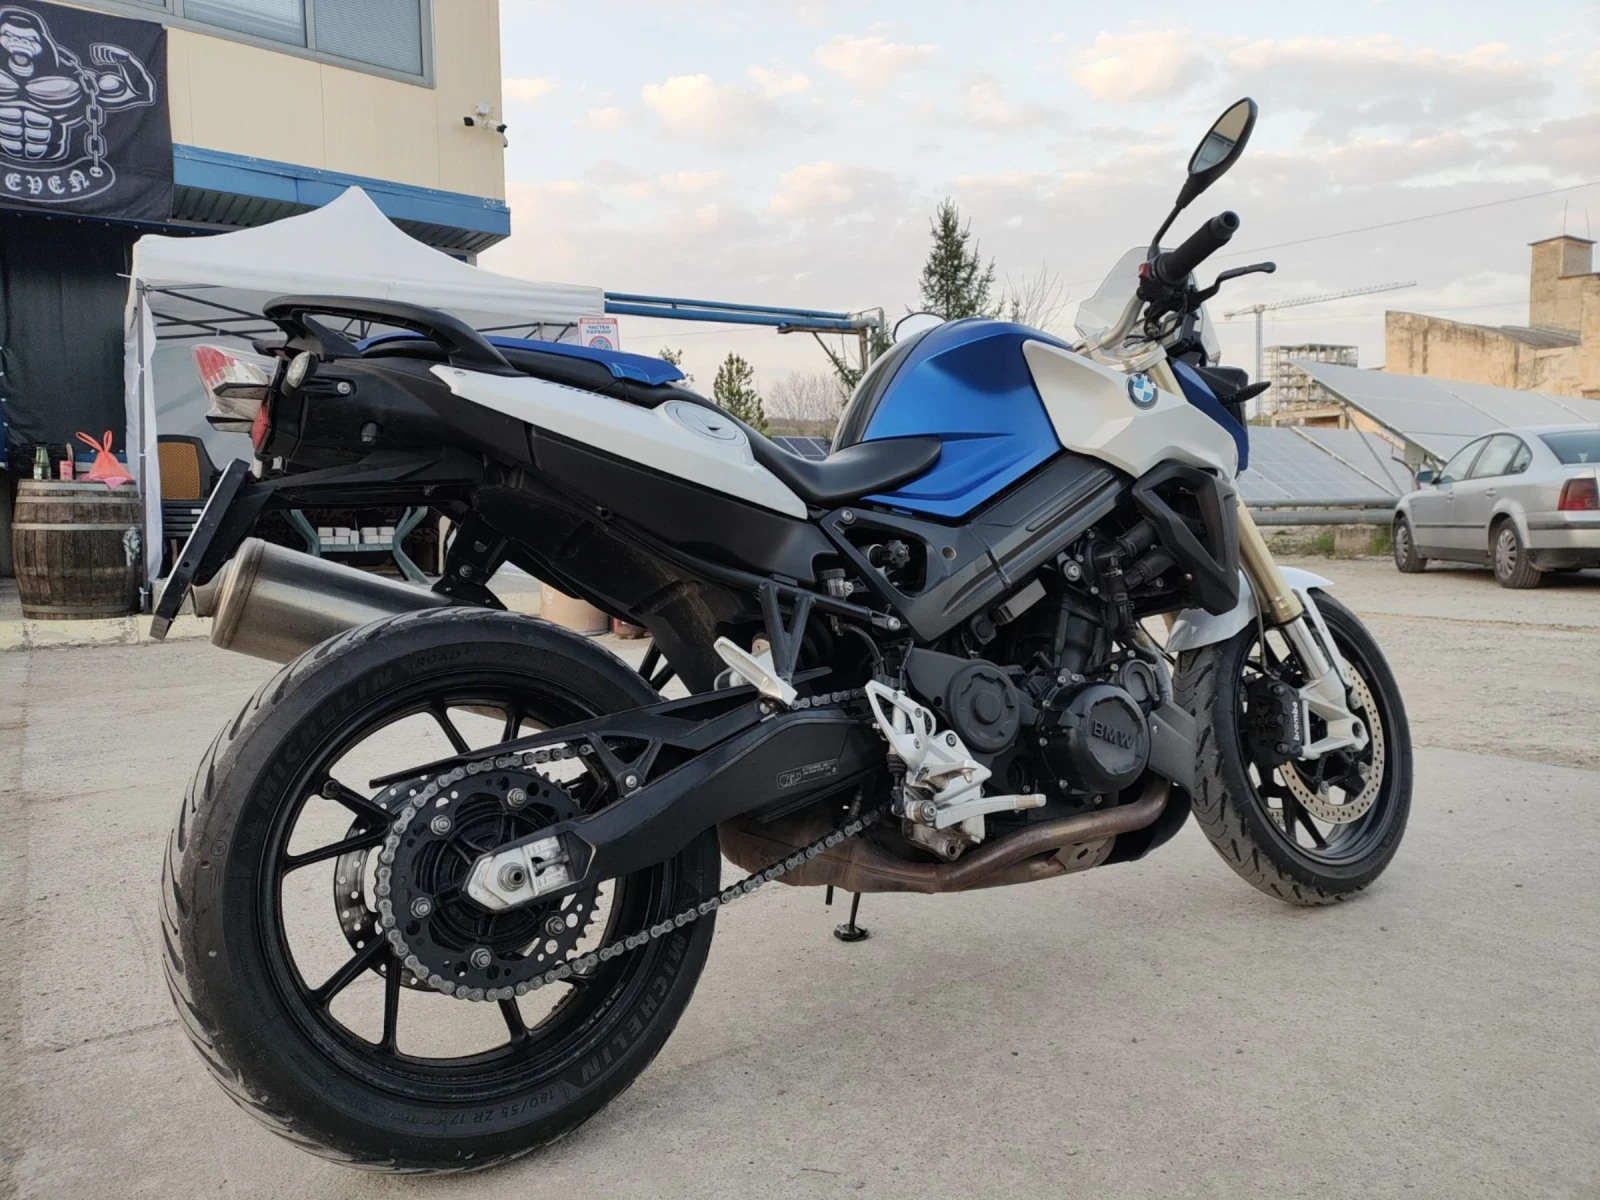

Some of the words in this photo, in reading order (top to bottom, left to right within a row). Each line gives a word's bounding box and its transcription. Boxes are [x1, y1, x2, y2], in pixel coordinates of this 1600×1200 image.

[1131, 373, 1157, 388] BMW
[1092, 719, 1133, 750] BMW
[1291, 701, 1300, 741] brembo
[255, 667, 393, 810] MICHELIN
[580, 933, 687, 1083] MICHELIN
[473, 1110, 494, 1124] ZR
[501, 1089, 555, 1119] 180/55
[449, 1113, 466, 1126] 17
